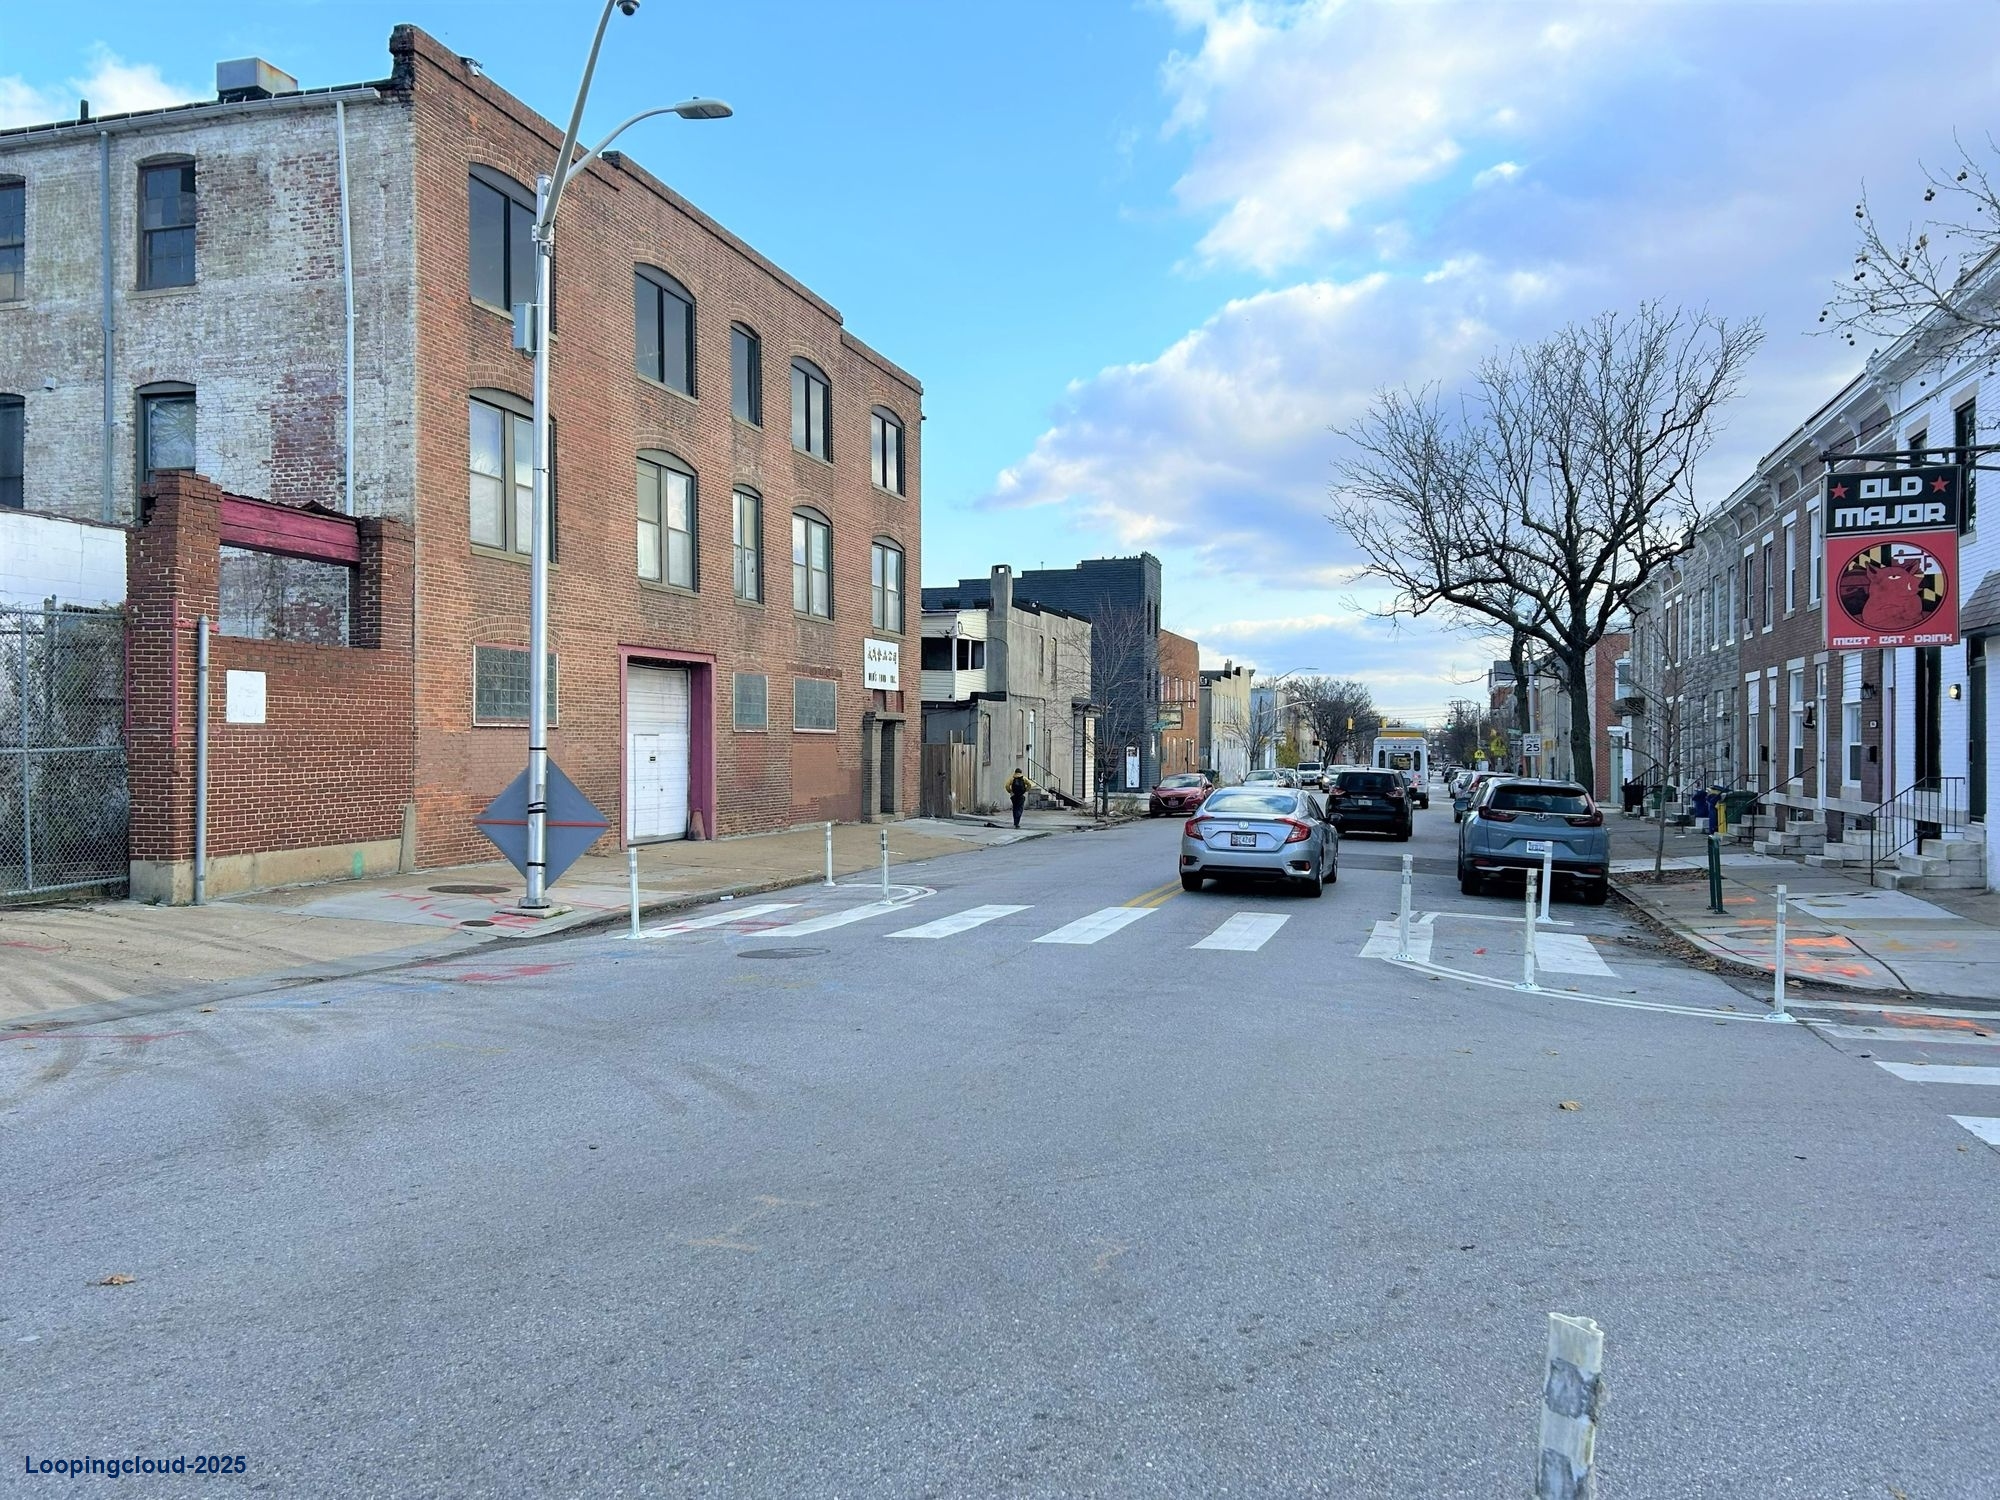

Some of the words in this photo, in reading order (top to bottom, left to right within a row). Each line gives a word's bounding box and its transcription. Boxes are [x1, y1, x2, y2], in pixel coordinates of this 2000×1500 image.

[1860, 476, 1923, 499] OLD
[1834, 502, 1946, 528] MAJOR
[1833, 636, 1871, 646] MEET
[1879, 635, 1906, 644] EAT
[1914, 633, 1953, 643] DRINK
[1526, 743, 1540, 751] 25
